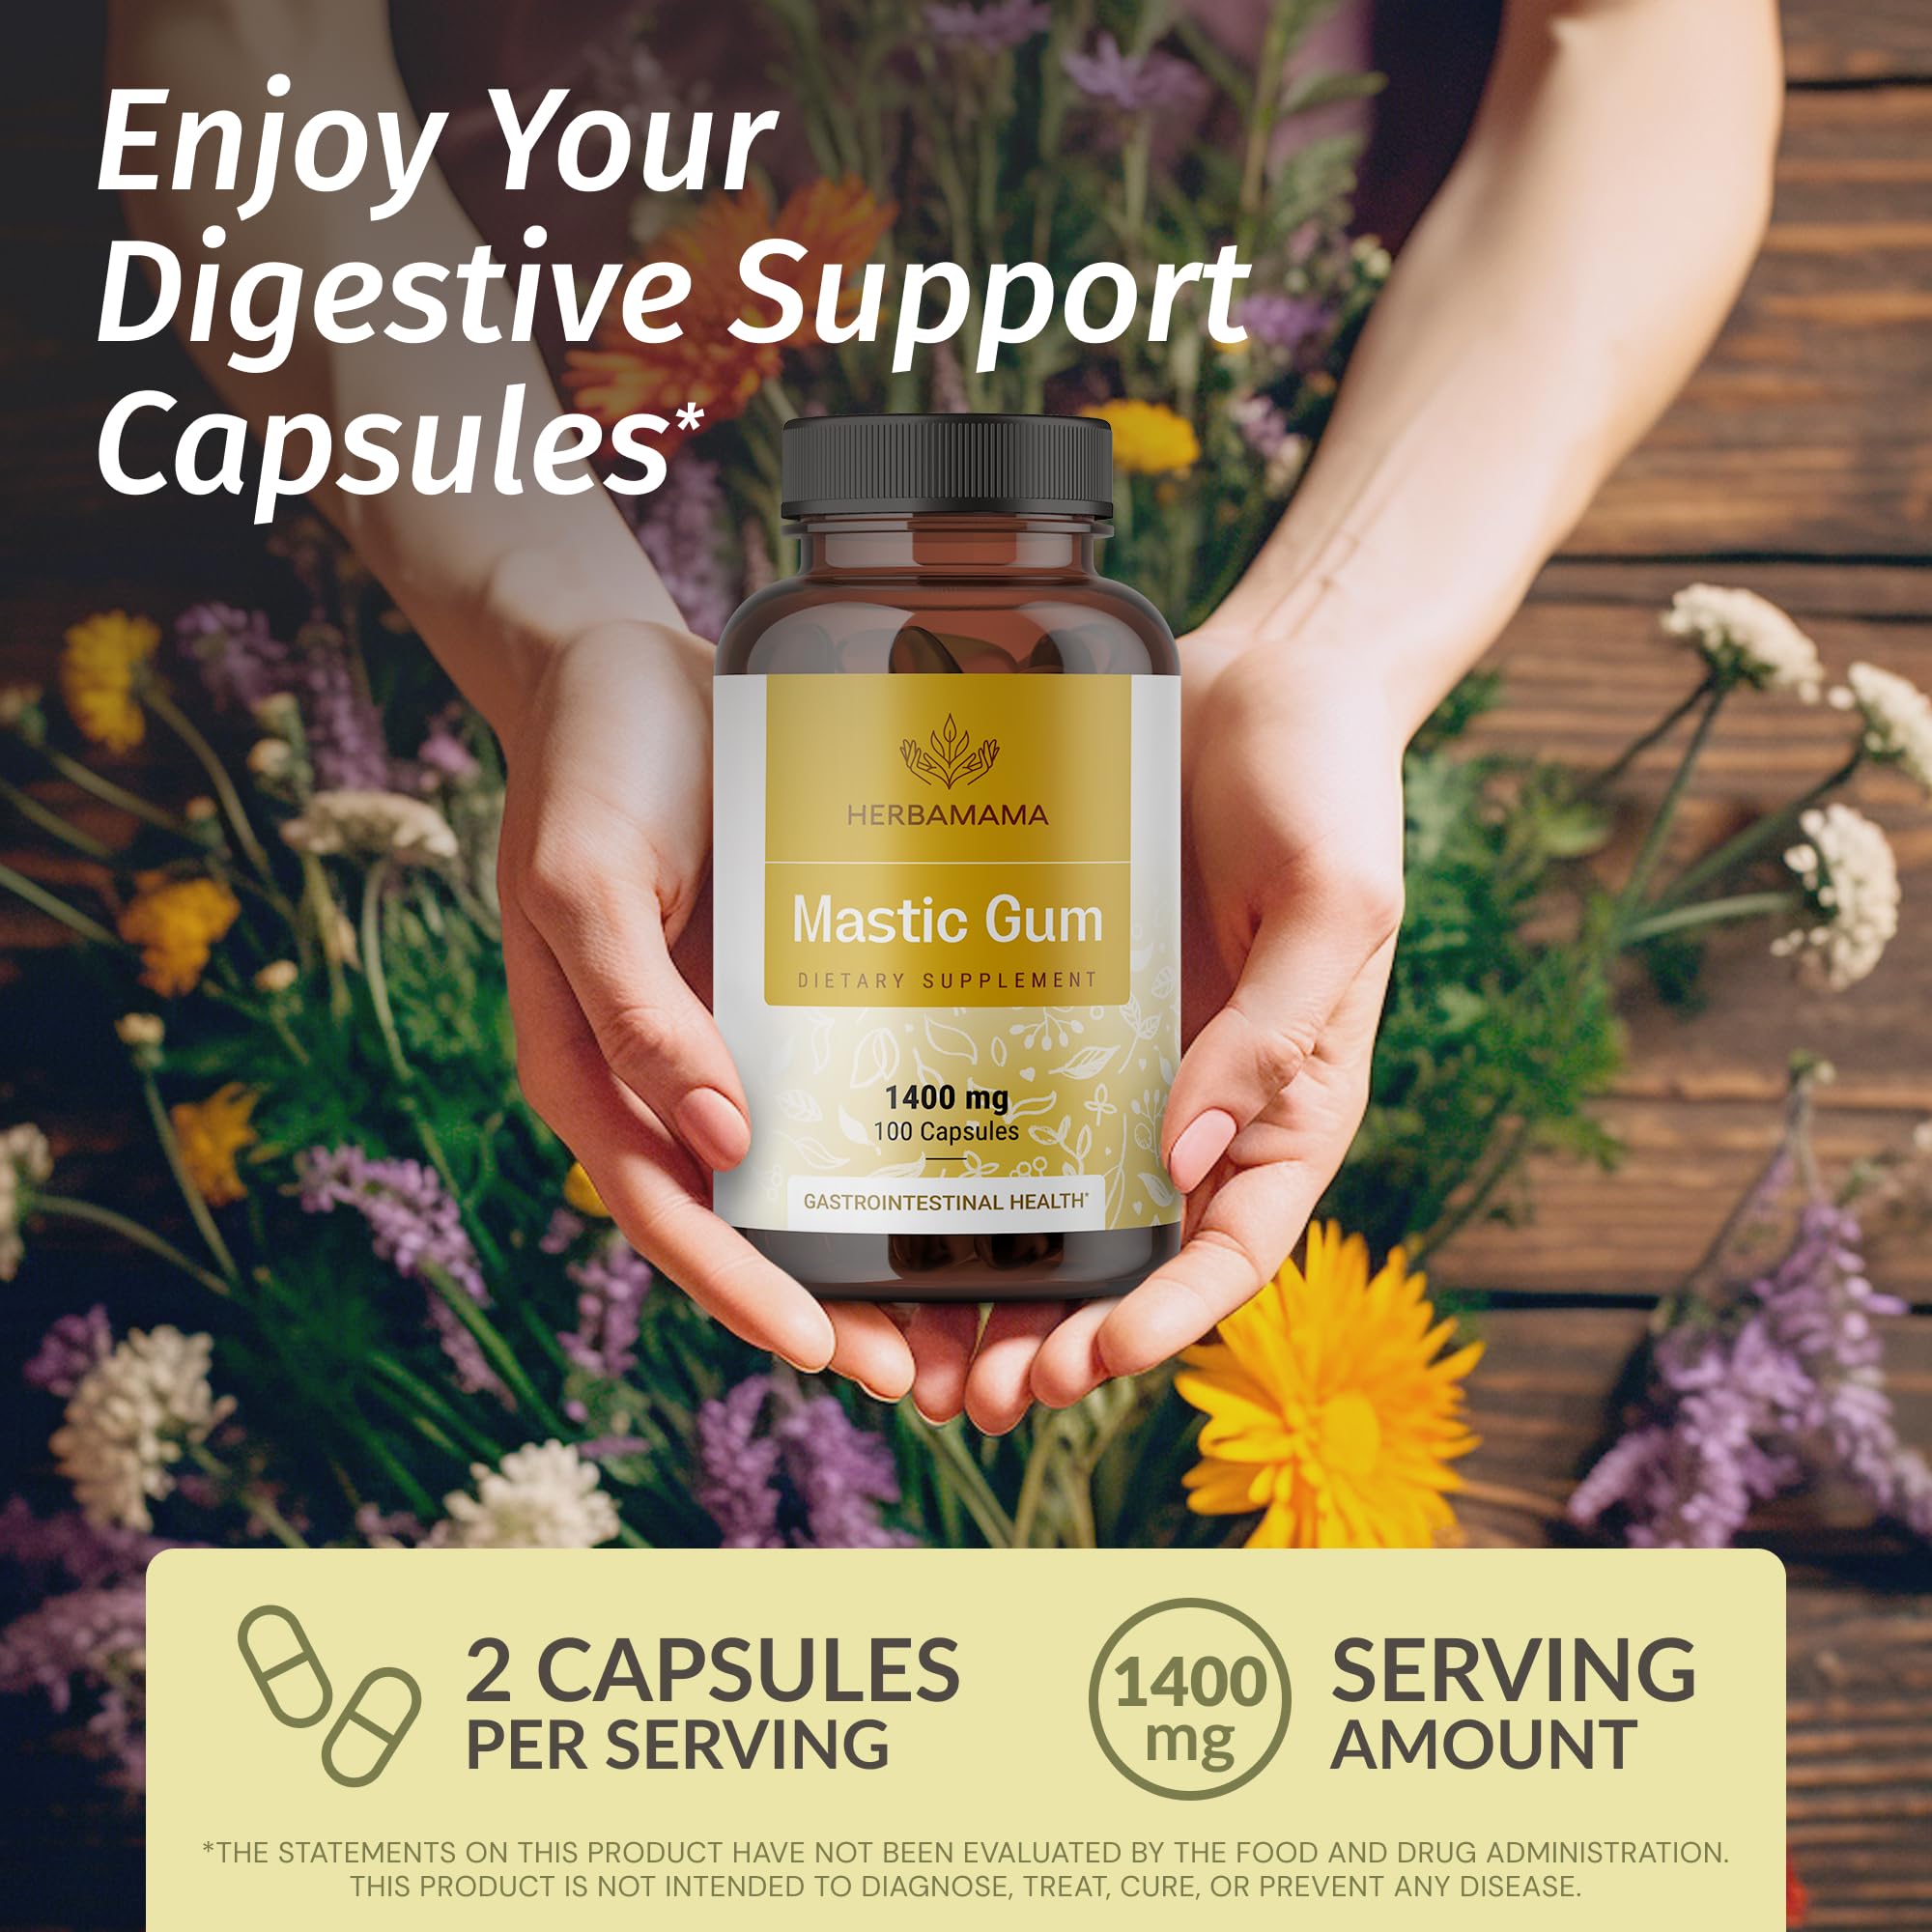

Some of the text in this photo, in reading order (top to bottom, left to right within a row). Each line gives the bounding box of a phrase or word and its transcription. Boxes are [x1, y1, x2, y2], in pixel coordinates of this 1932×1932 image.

[847, 804, 1050, 826] HERBAMAMA
[793, 894, 1103, 944] Mastic Gum
[798, 971, 1096, 989] DIETARY SUPPLEMENT
[885, 1084, 1009, 1116] 1400 mg
[874, 1121, 1020, 1147] 100 Capsules
[804, 1193, 1005, 1211] GASTROINTESTINAL
